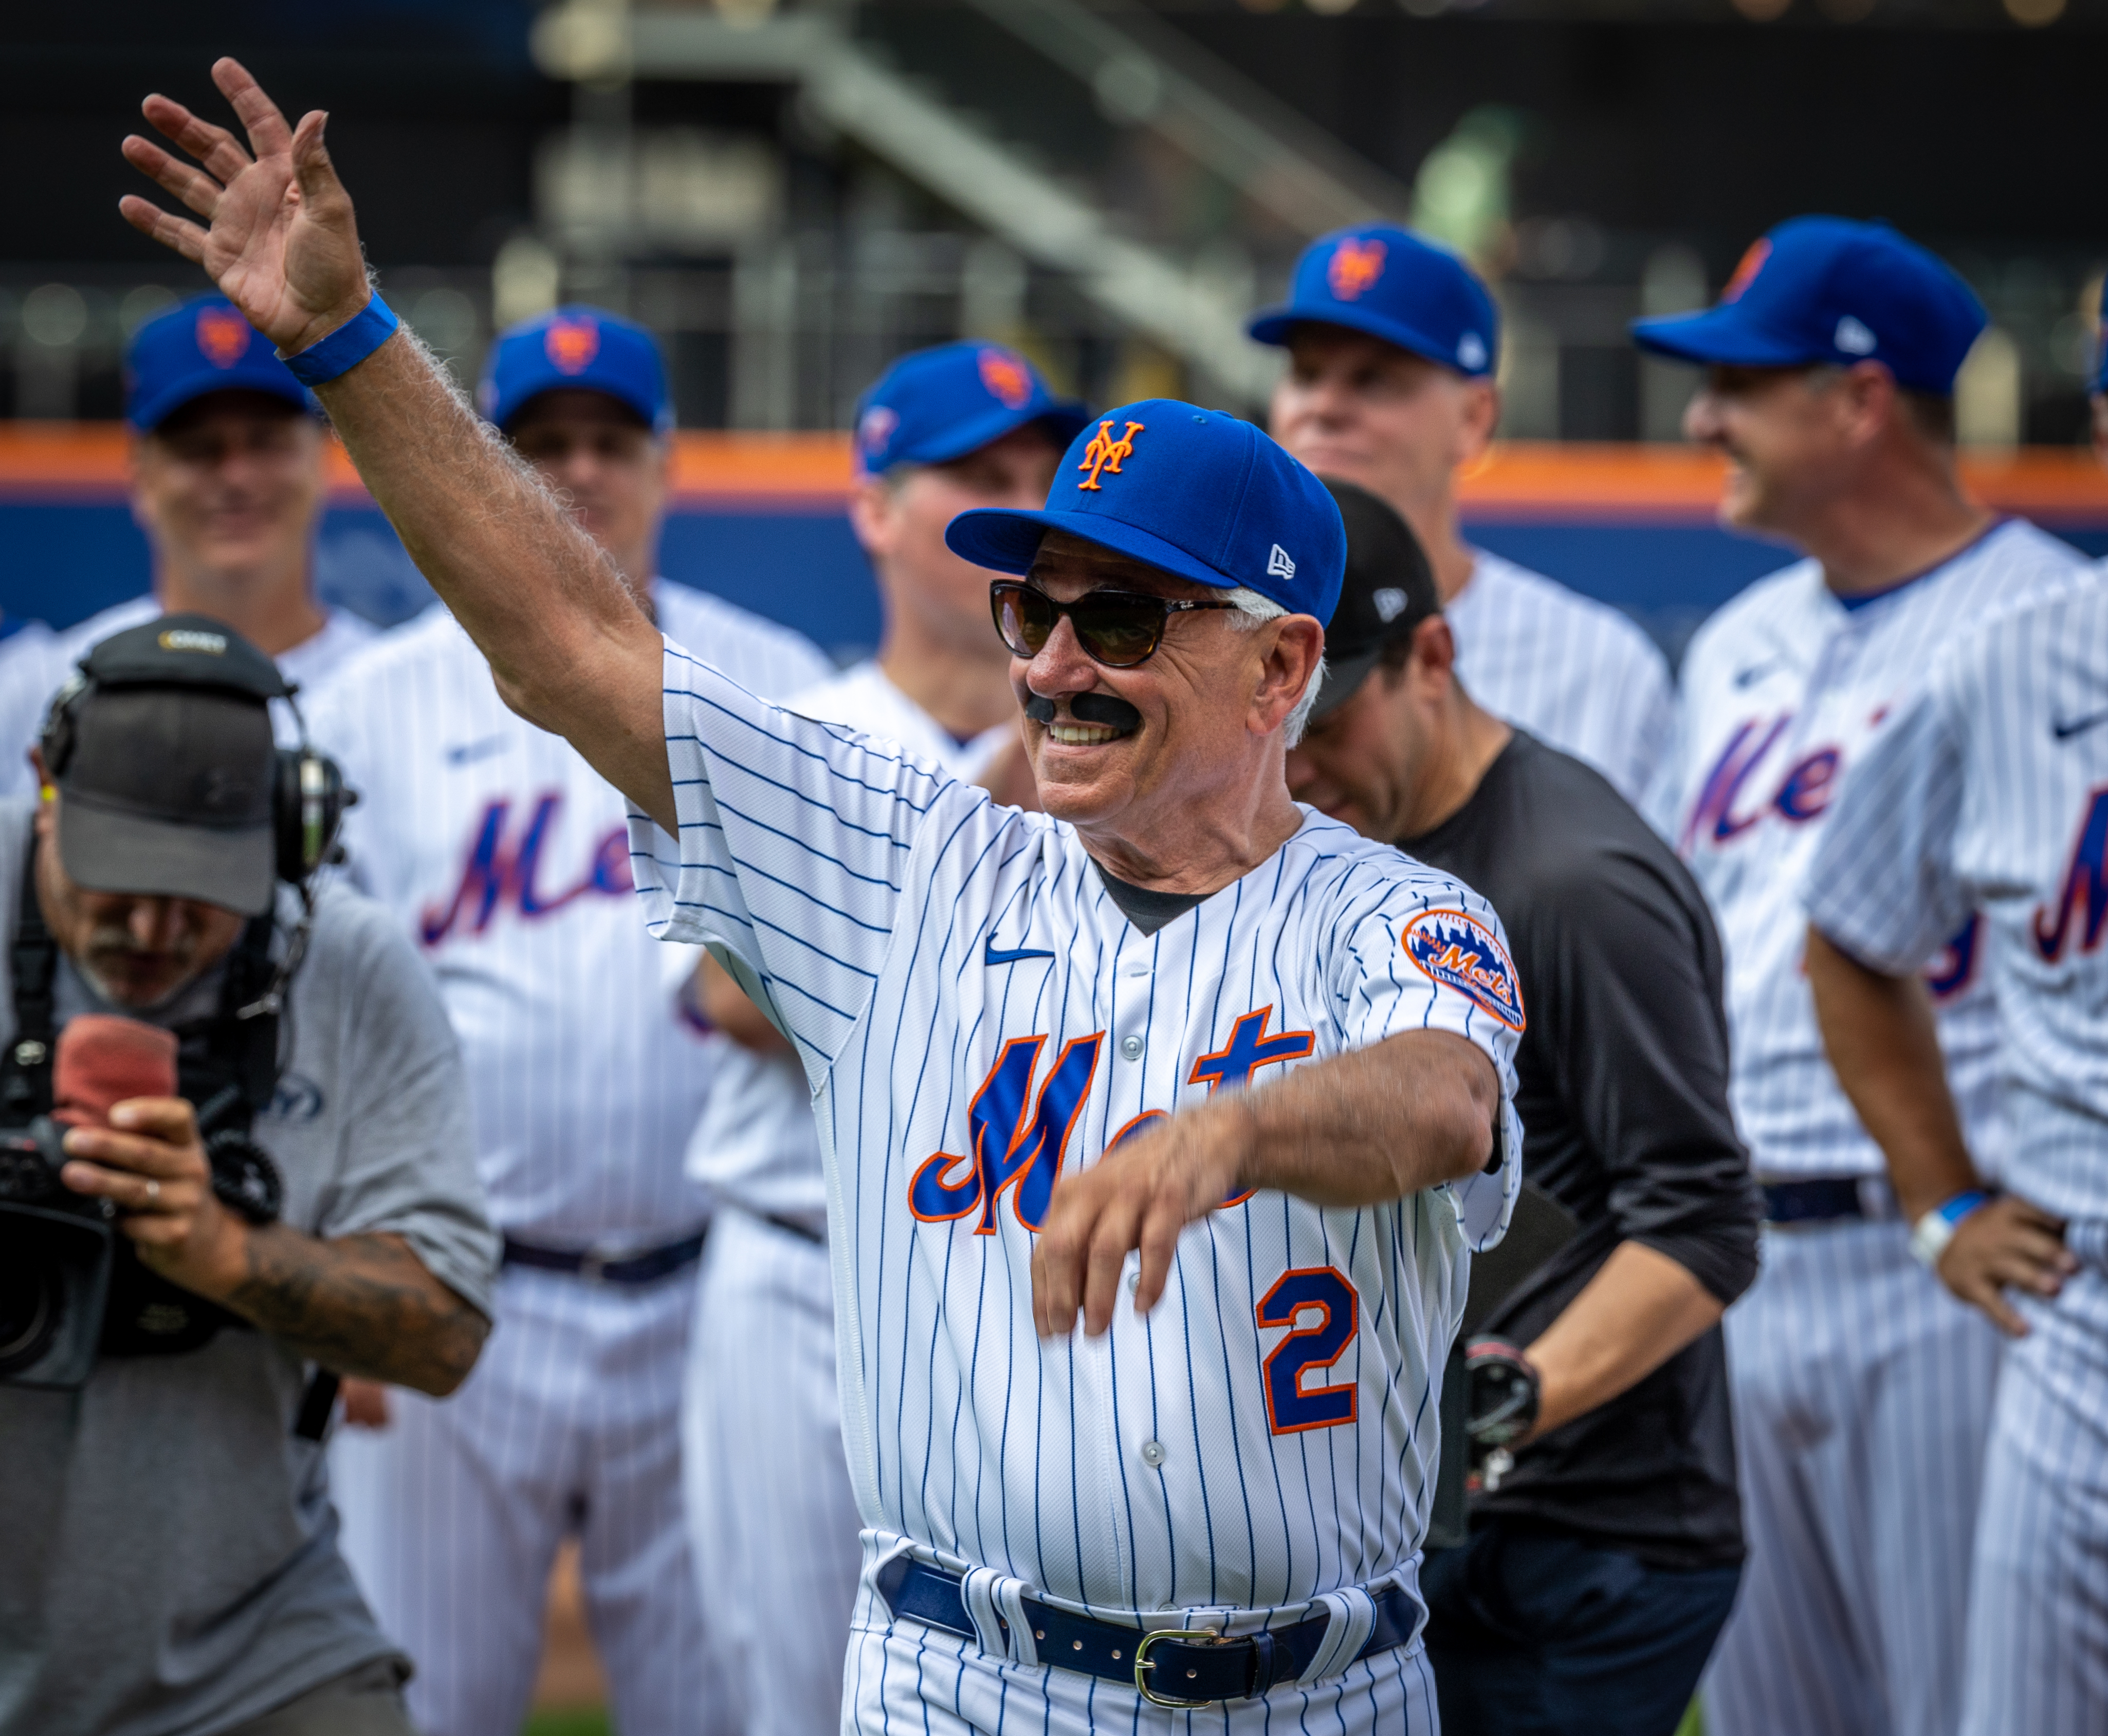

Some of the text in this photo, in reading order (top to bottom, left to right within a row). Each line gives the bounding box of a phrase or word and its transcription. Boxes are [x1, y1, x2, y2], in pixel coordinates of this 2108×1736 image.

[1078, 420, 1145, 491] NY
[1427, 943, 1512, 1007] Mets
[1255, 1266, 1359, 1436] 2
